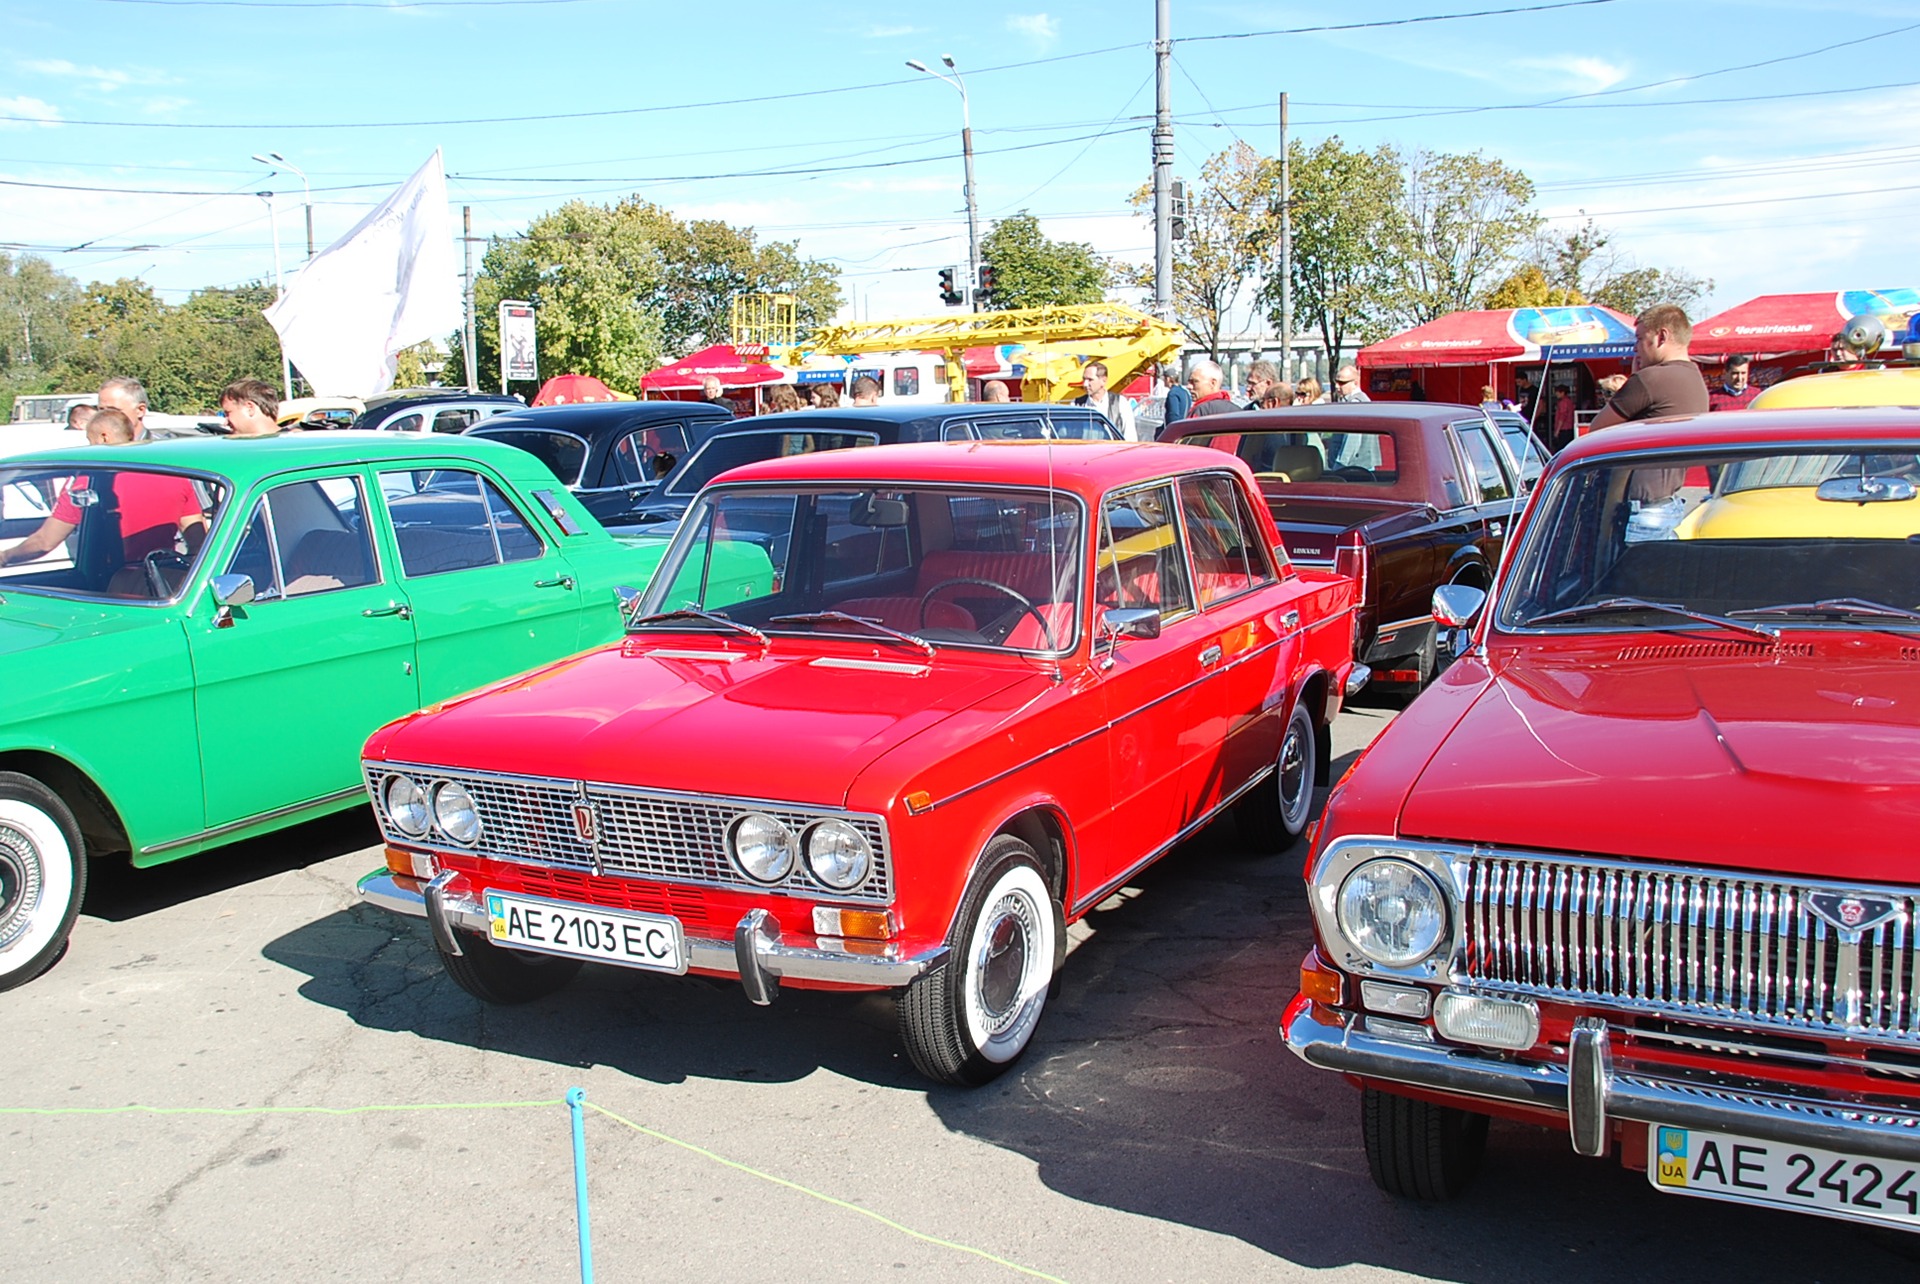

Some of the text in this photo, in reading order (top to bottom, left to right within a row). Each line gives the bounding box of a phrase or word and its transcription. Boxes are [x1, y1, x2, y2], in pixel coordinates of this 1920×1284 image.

[494, 924, 506, 934] UA
[508, 906, 670, 960] AE 2103 EC
[1662, 1164, 1684, 1179] UA
[1692, 1140, 1918, 1215] AE 2424
